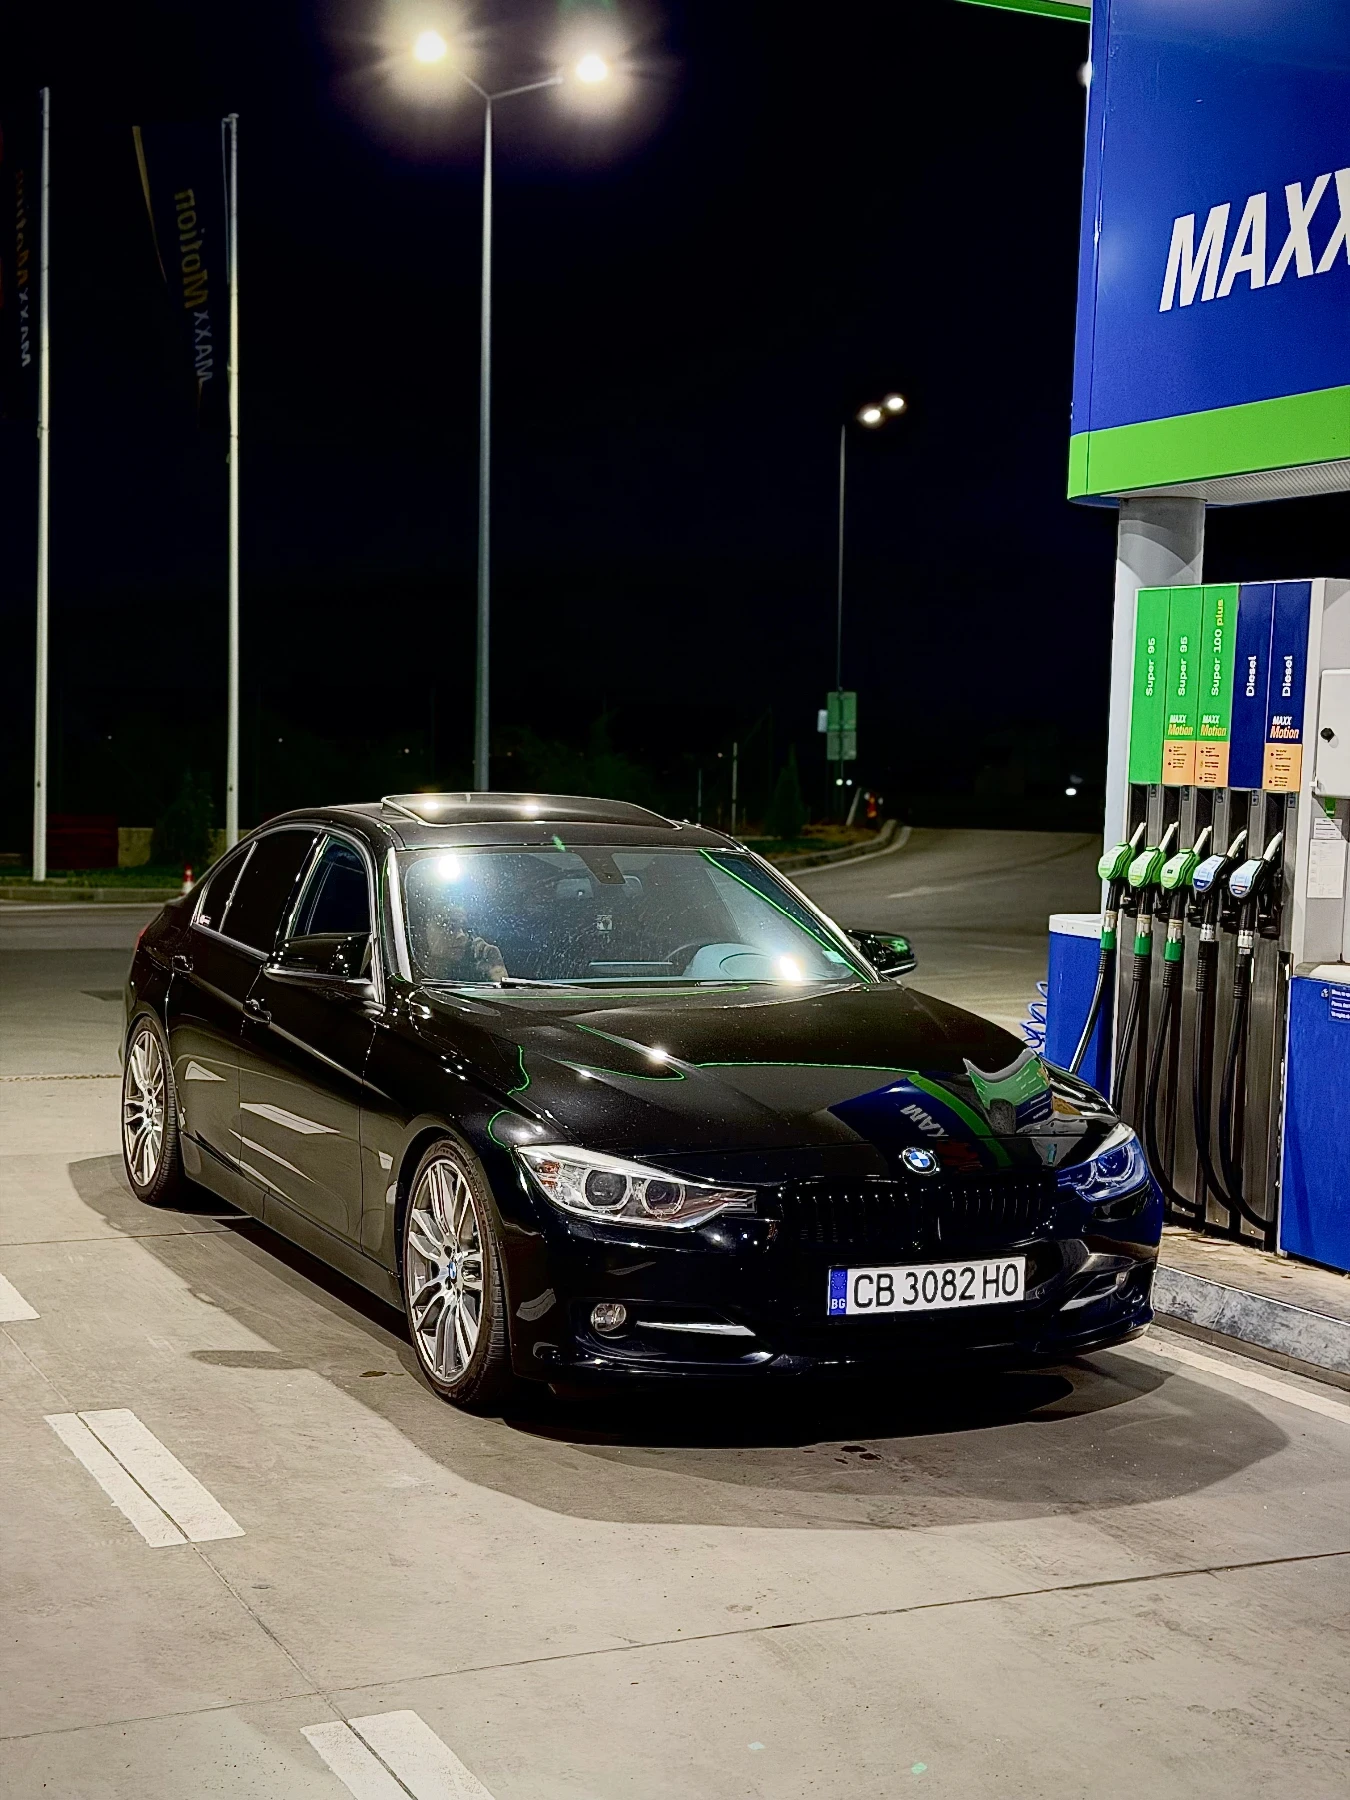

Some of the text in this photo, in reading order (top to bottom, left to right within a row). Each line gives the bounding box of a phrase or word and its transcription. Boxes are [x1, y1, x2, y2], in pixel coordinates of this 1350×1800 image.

[1211, 598, 1224, 696] Super 100 plus
[1145, 637, 1156, 696] Super 95
[1178, 636, 1188, 696] Super 95
[1246, 655, 1256, 696] Diesel
[1282, 655, 1292, 696] Diesel
[1169, 714, 1186, 724] MAXX
[1202, 714, 1220, 724] MAXX
[1272, 715, 1292, 726] MAXX
[1168, 723, 1193, 736] Motion
[1200, 724, 1227, 737] Motion
[1269, 725, 1300, 739] Motion
[902, 1268, 976, 1306] 3082
[831, 1298, 846, 1310] BG
